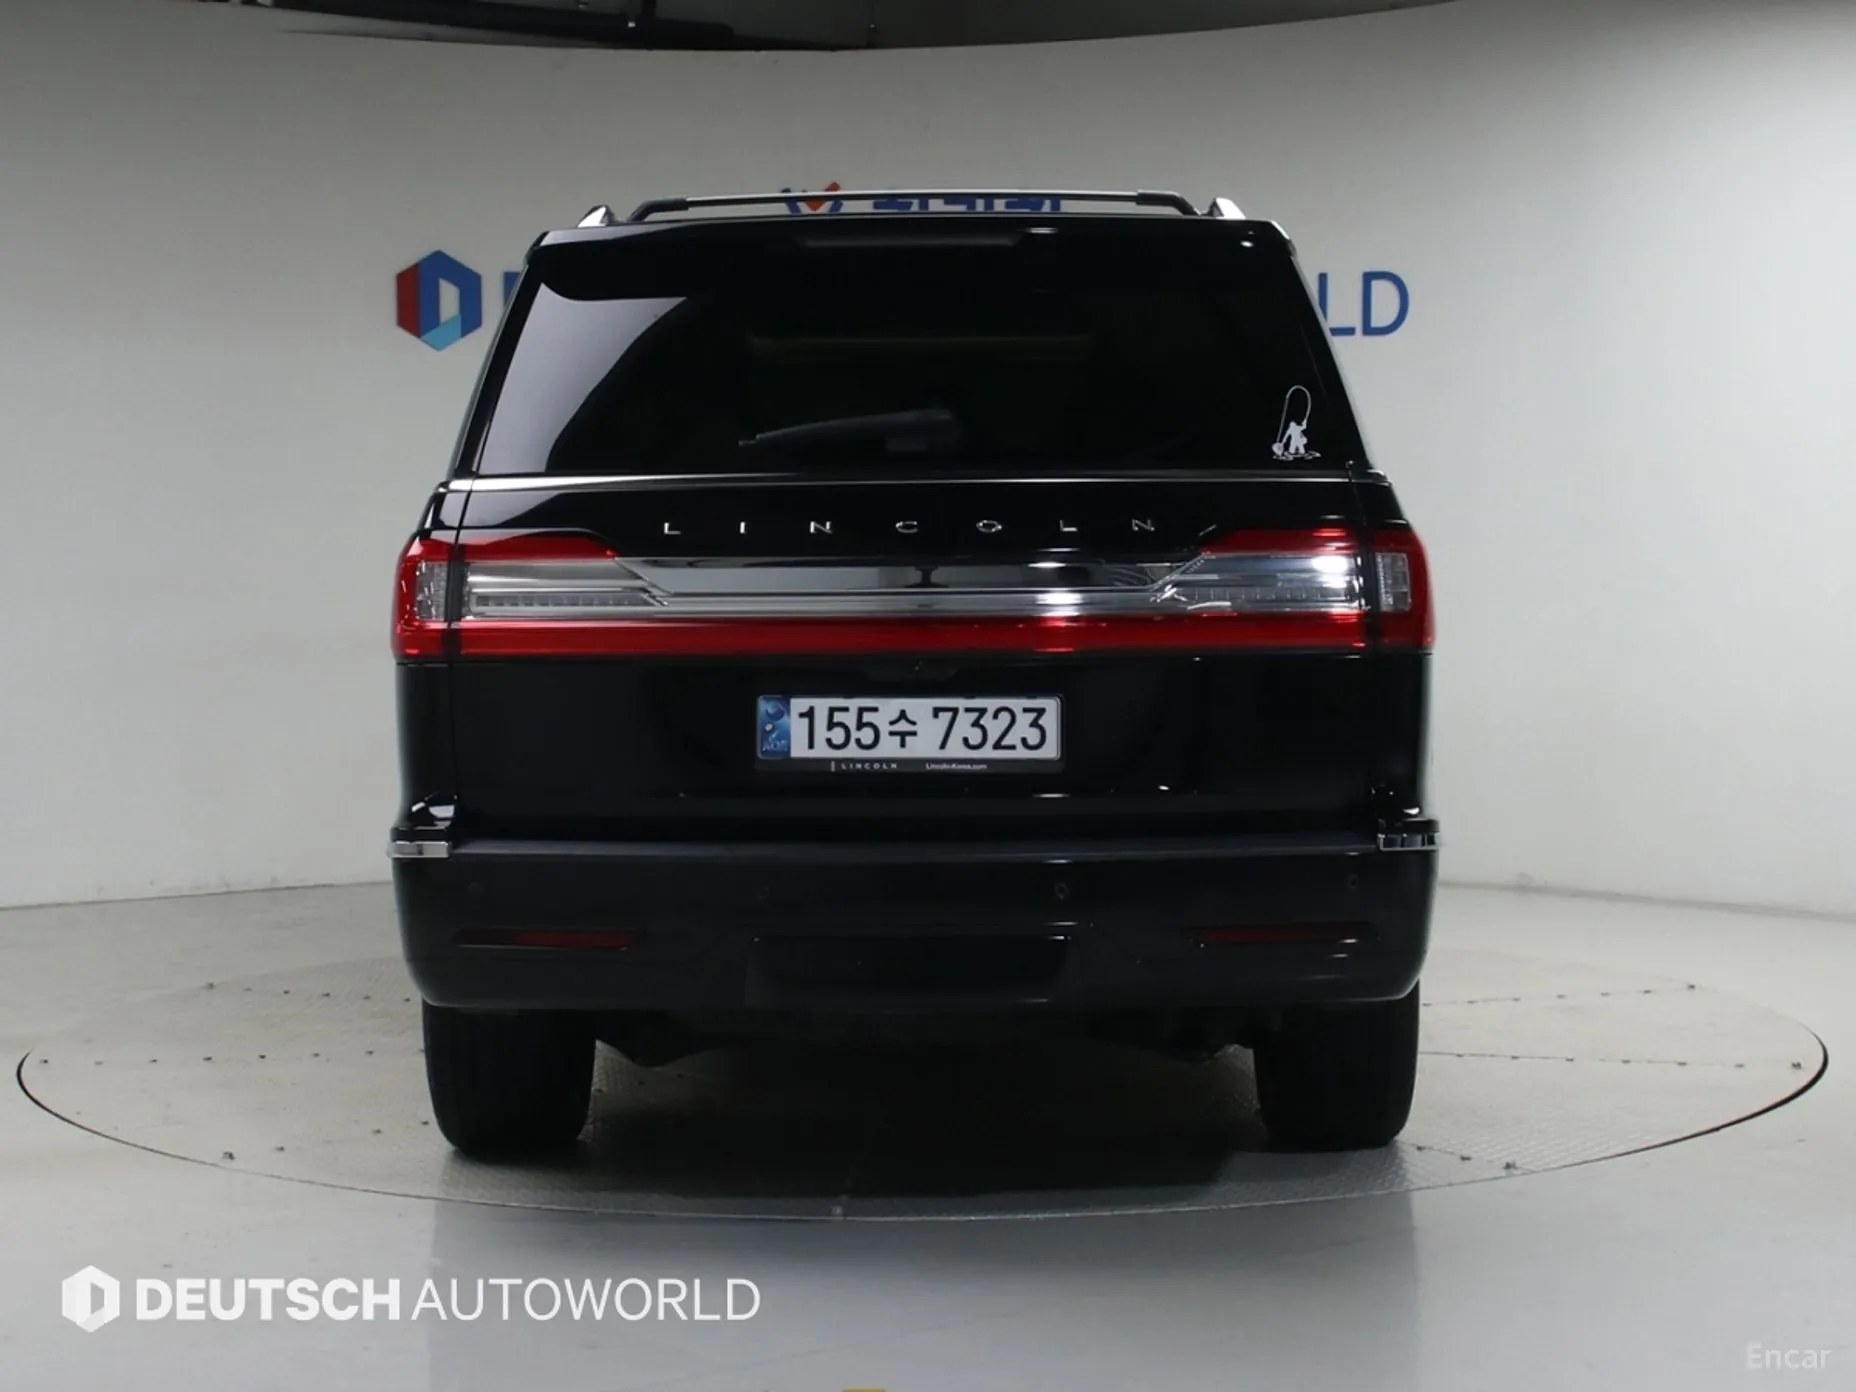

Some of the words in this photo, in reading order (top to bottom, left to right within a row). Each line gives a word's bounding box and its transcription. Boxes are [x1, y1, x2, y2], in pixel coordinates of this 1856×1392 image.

[663, 518, 1155, 536] LINCOLN
[798, 705, 918, 751] 155수
[932, 706, 1047, 751] 7323
[840, 762, 898, 771] LINCOLN
